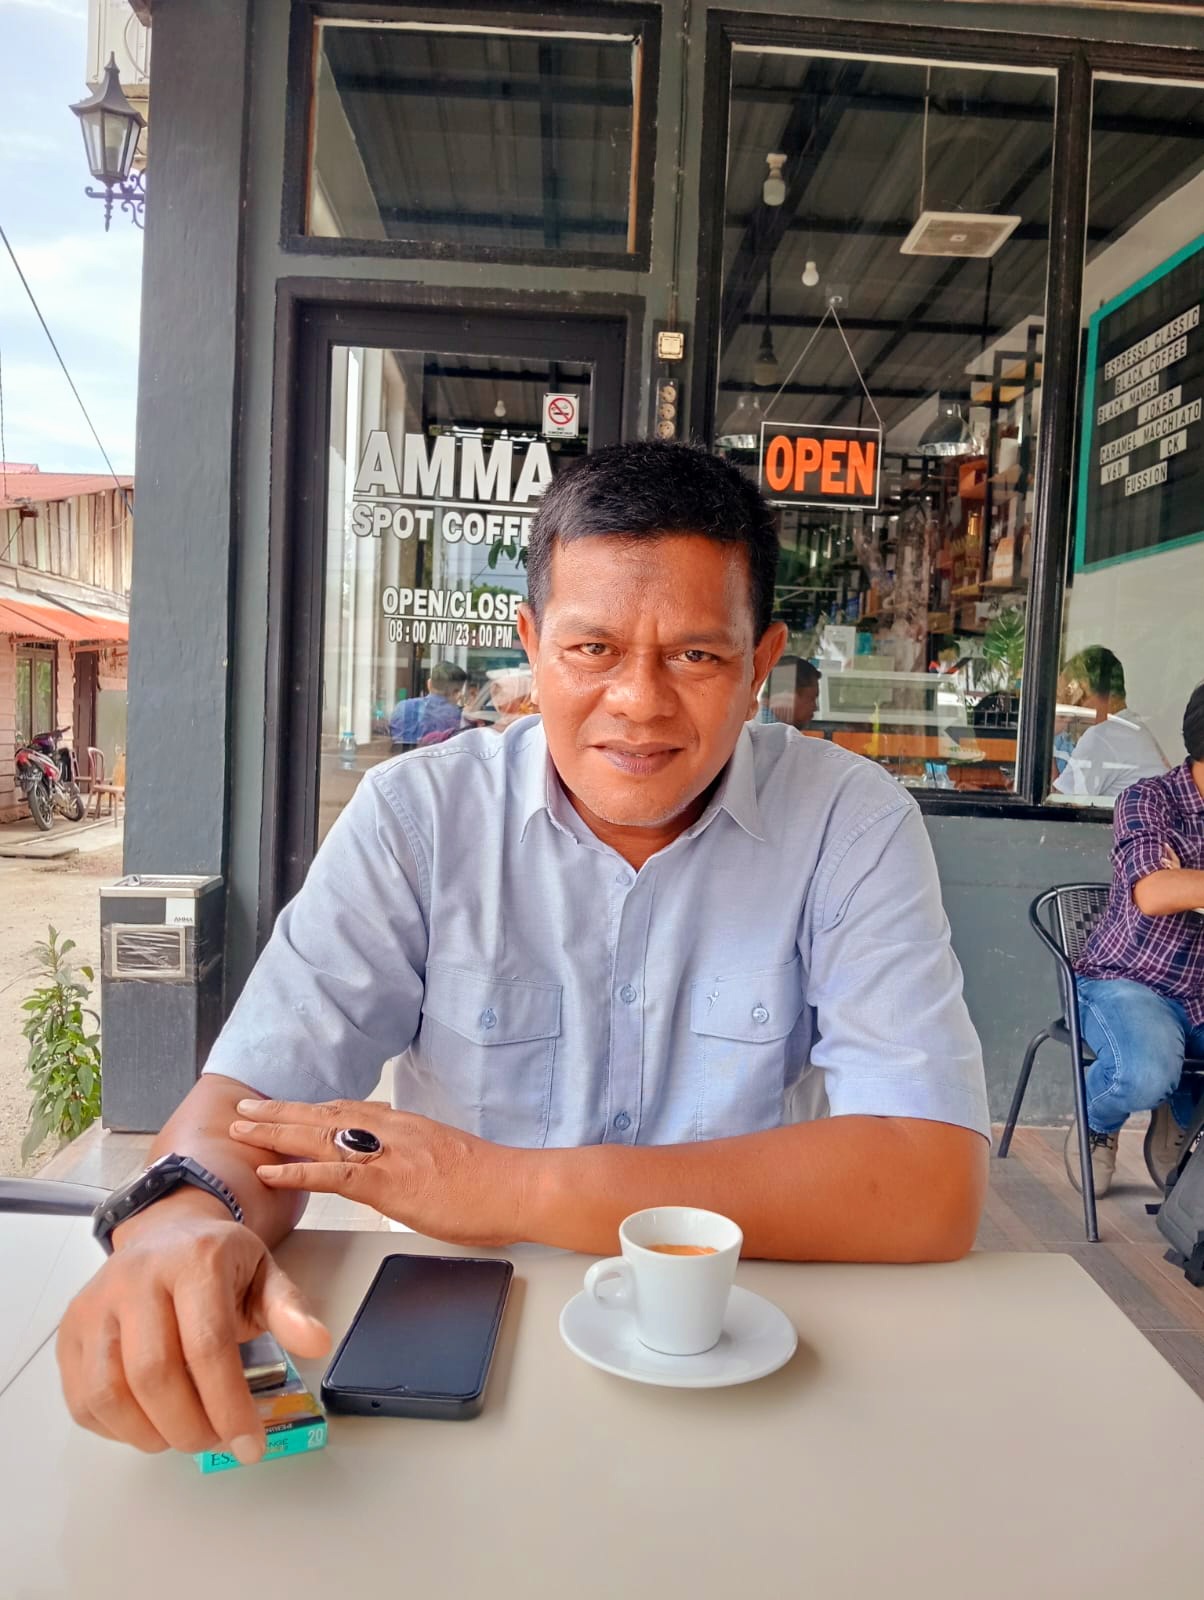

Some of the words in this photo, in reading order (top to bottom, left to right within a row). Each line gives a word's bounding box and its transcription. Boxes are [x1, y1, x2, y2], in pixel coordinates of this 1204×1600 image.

[1106, 340, 1148, 379] ESPRESSO
[1154, 309, 1198, 348] CLASSIC
[1116, 365, 1143, 393] BLACK
[1149, 340, 1185, 373] COFFEE
[1098, 398, 1124, 423] BLACK
[1130, 378, 1157, 405] MAMBA
[1144, 393, 1174, 421] JOKER
[1101, 433, 1137, 463] CARAMEL
[1143, 402, 1200, 442] MACCHIATO
[1167, 435, 1180, 455] CK
[354, 430, 553, 503] AMMA
[765, 435, 875, 495] OPEN
[1107, 462, 1122, 481] V60
[1126, 464, 1167, 493] FUSSION
[352, 504, 434, 540] SPOT
[442, 511, 532, 547] COFFE
[389, 619, 403, 642] 08
[412, 620, 427, 643] 00
[428, 621, 447, 645] AM
[455, 623, 470, 646] 23
[479, 624, 493, 647] 00
[495, 626, 513, 648] PM
[308, 1428, 323, 1443] 20
